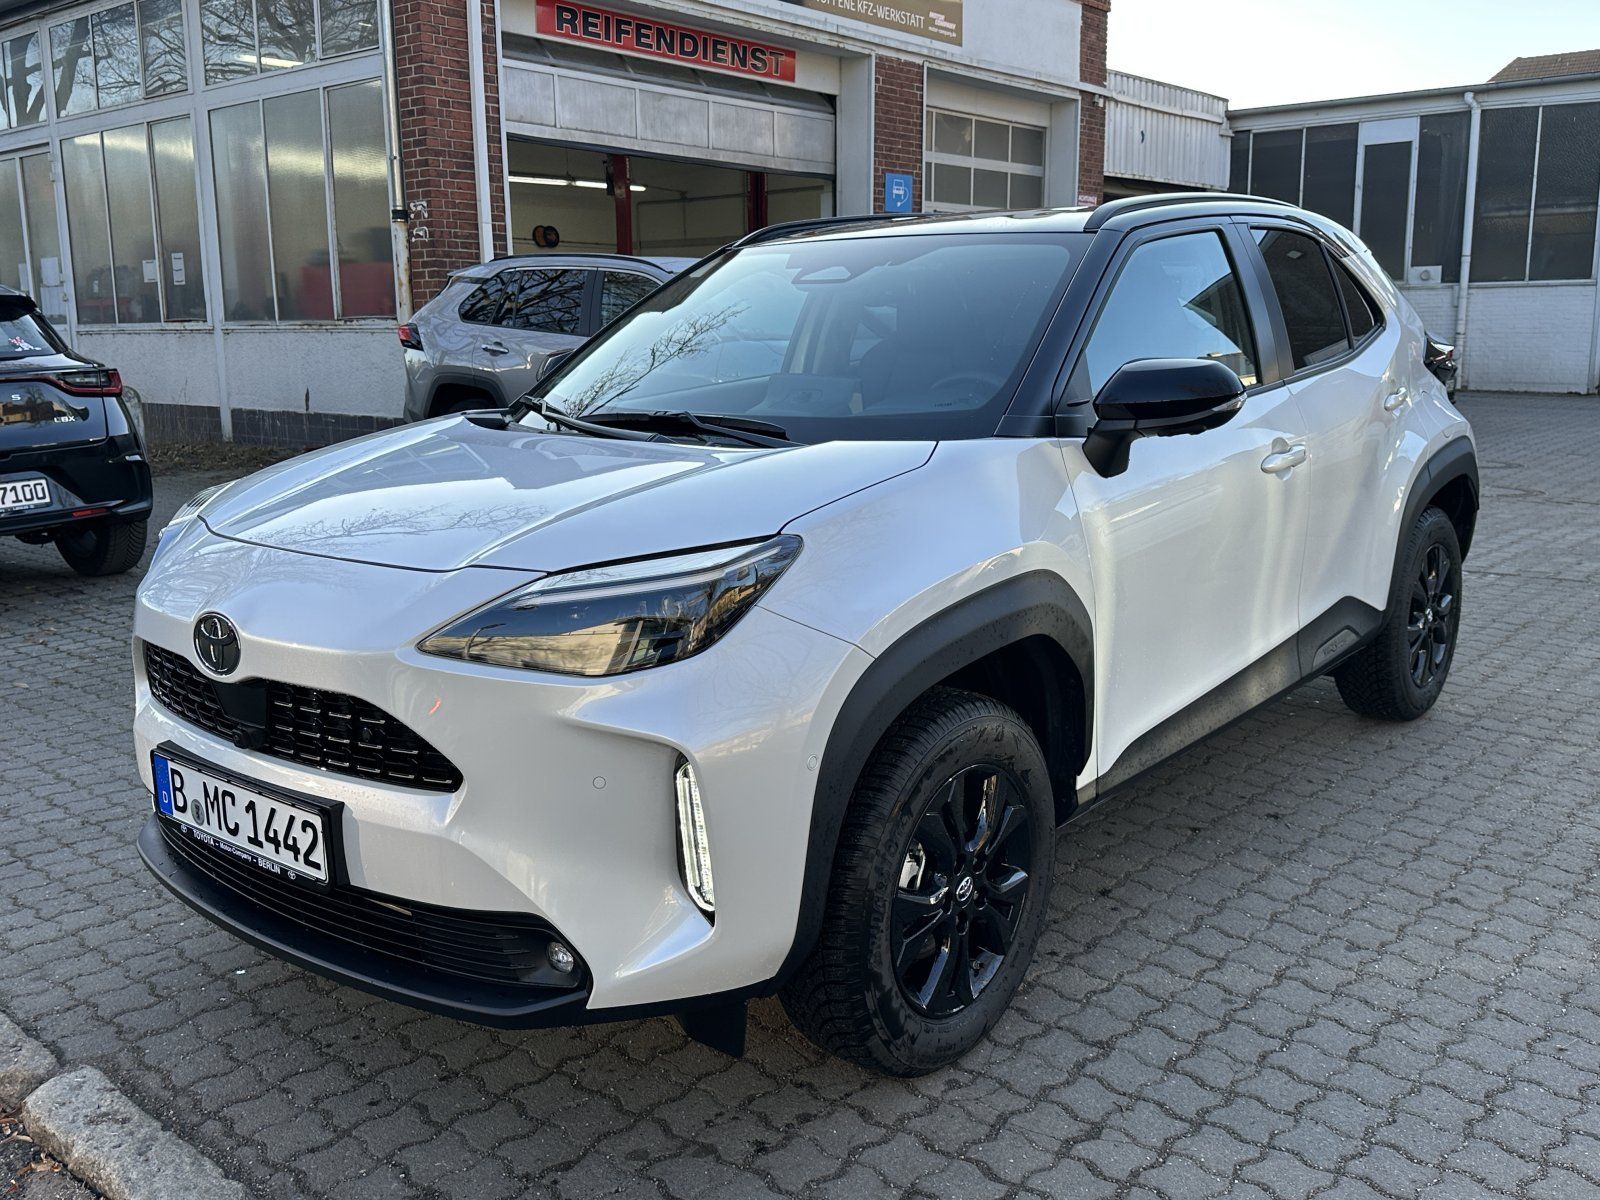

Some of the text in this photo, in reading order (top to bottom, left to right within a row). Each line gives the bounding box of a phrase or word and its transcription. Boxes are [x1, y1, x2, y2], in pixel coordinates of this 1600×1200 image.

[857, 0, 925, 28] KFZ-WERKSTATT
[555, 4, 785, 76] REIFENDIENST
[53, 415, 76, 423] LBX
[0, 482, 47, 505] 7100
[162, 790, 169, 803] D
[171, 767, 322, 871] B MC 1442
[193, 829, 214, 846] TOYOTA
[258, 857, 281, 874] BERLIN
